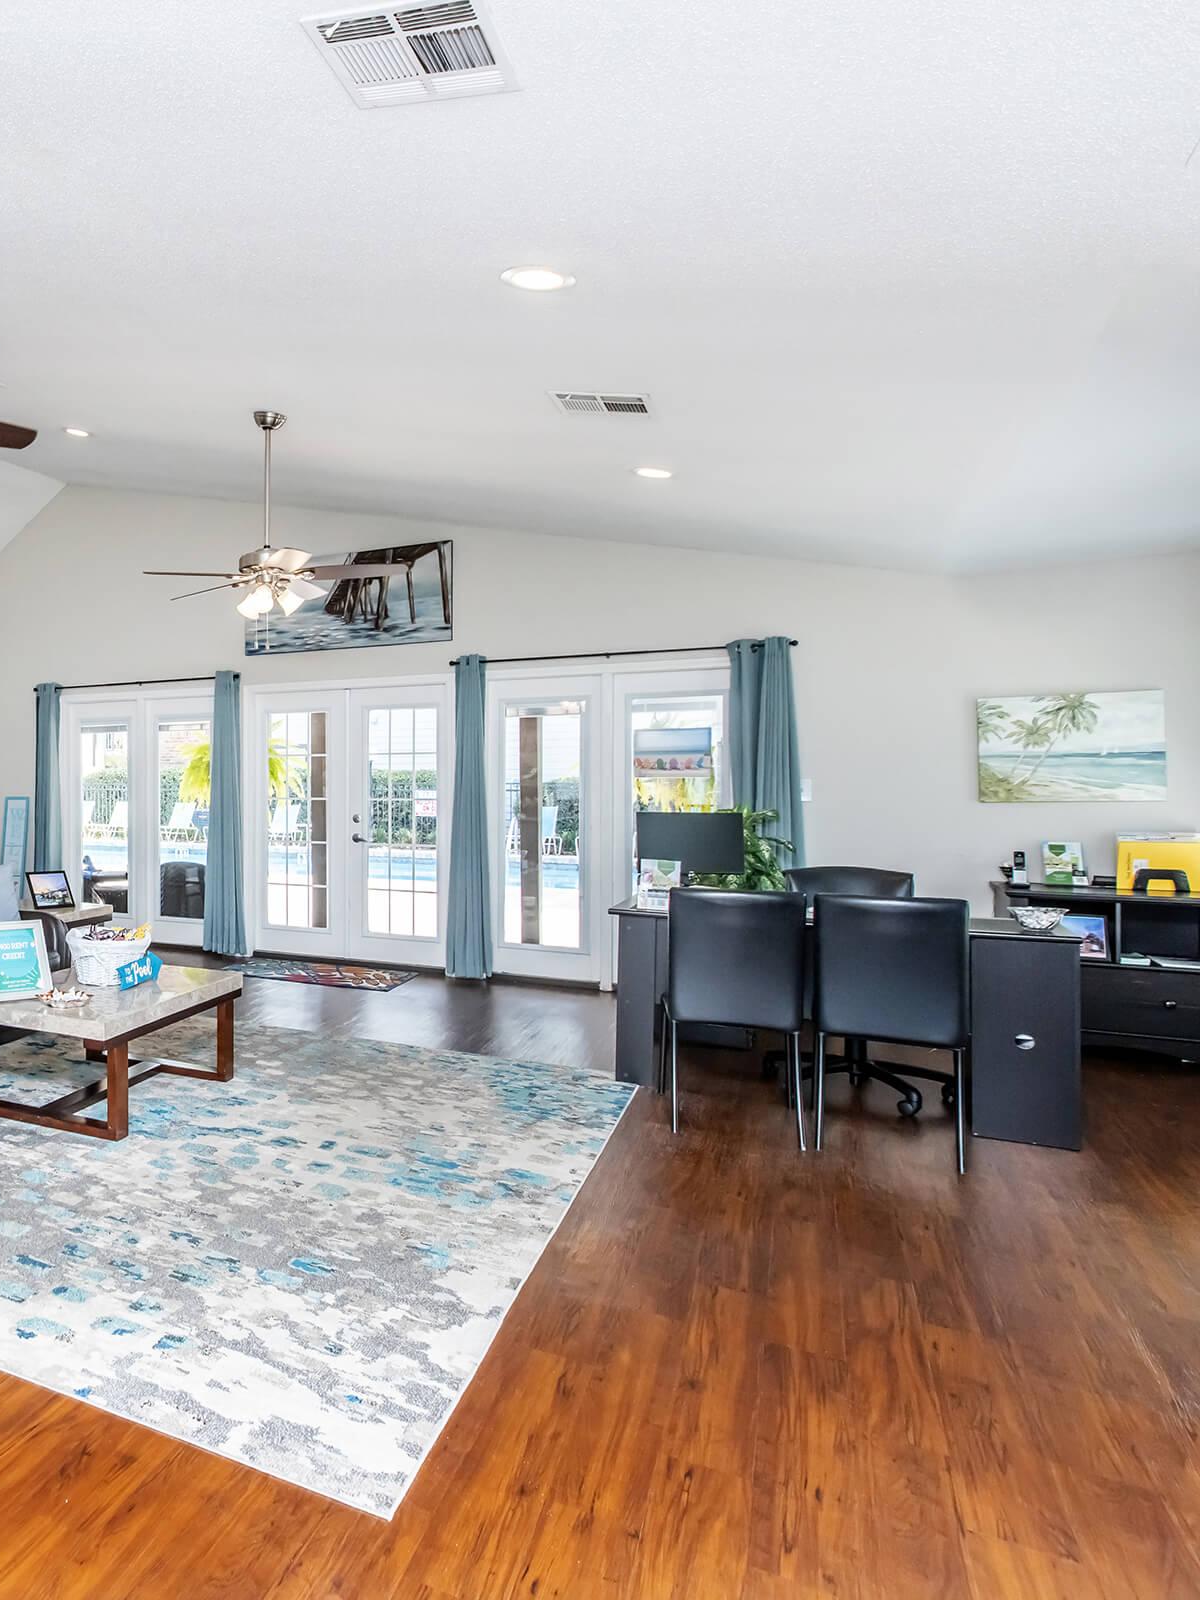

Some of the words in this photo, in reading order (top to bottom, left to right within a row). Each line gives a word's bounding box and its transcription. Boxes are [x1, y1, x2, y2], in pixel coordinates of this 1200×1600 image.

[11, 941, 29, 950] RENT
[1, 952, 26, 960] CREDIT
[131, 957, 152, 985] Pool
[125, 975, 134, 984] THE
